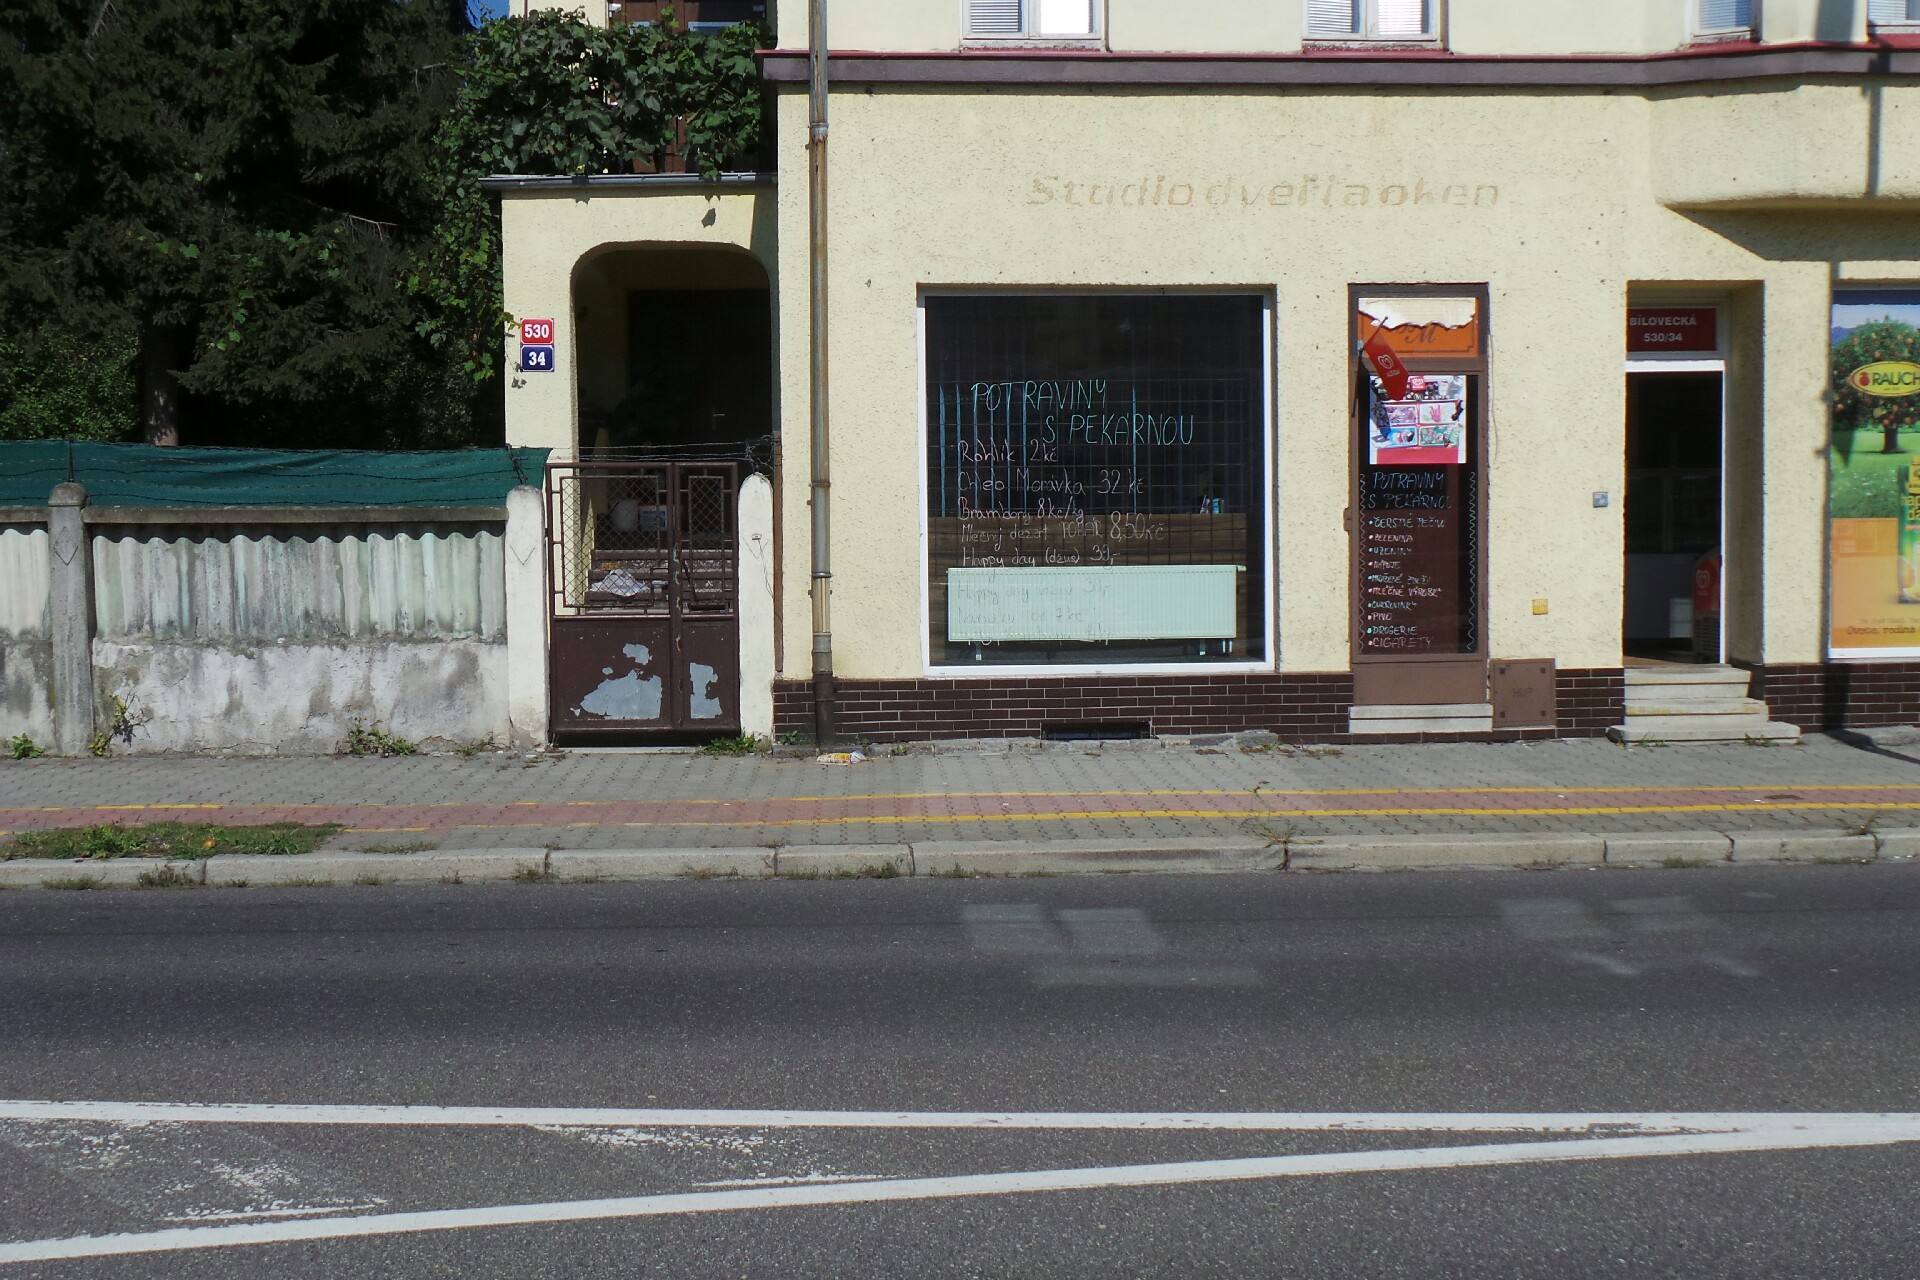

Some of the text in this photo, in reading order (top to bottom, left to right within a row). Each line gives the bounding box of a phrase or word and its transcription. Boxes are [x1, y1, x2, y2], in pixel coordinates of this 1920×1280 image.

[1026, 175, 1194, 207] Studio
[1629, 314, 1697, 326] BÍLOVECKÁ
[524, 323, 550, 339] 530
[1643, 332, 1683, 342] 530/34
[528, 351, 546, 366] 34
[970, 379, 1107, 411] POTRAVINY
[1042, 412, 1194, 446] S PEKÁRNOU
[1016, 467, 1086, 496] Morávka
[1368, 494, 1376, 509] S
[962, 546, 1005, 569] Happy
[1011, 547, 1036, 569] day
[1371, 612, 1393, 622] PIVO
[1372, 625, 1418, 636] DROGERIE
[1373, 636, 1433, 649] CIGARETY
